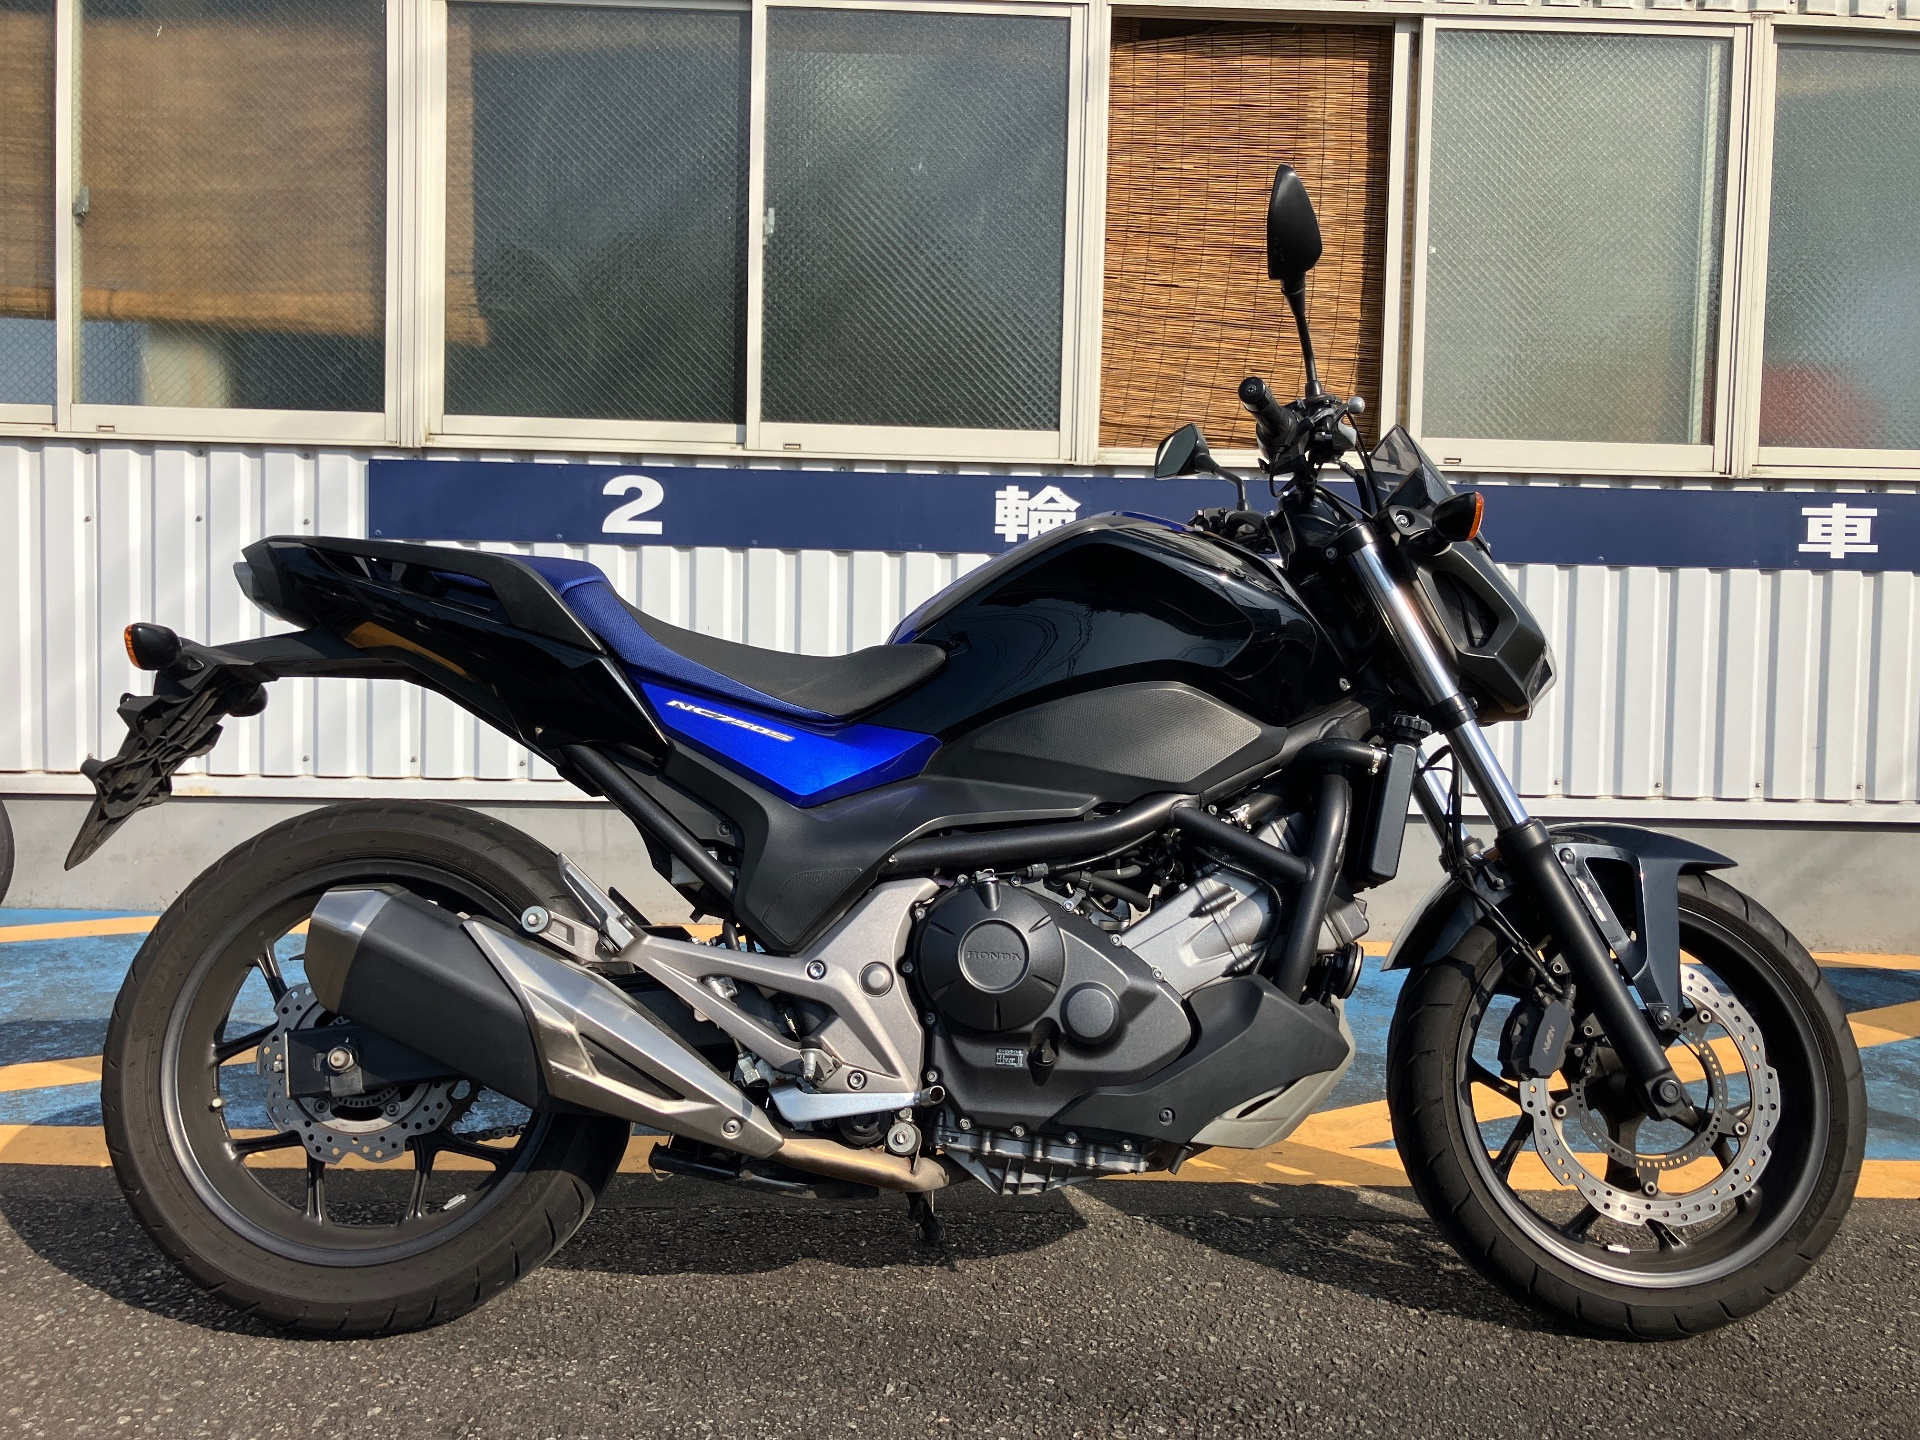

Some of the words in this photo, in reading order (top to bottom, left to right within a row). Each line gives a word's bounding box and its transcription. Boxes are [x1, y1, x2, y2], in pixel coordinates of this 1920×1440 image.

[602, 474, 664, 535] 2
[994, 485, 1081, 542] 輪
[1798, 503, 1878, 559] 車
[666, 700, 794, 742] NC750S
[967, 950, 1022, 961] HONDA
